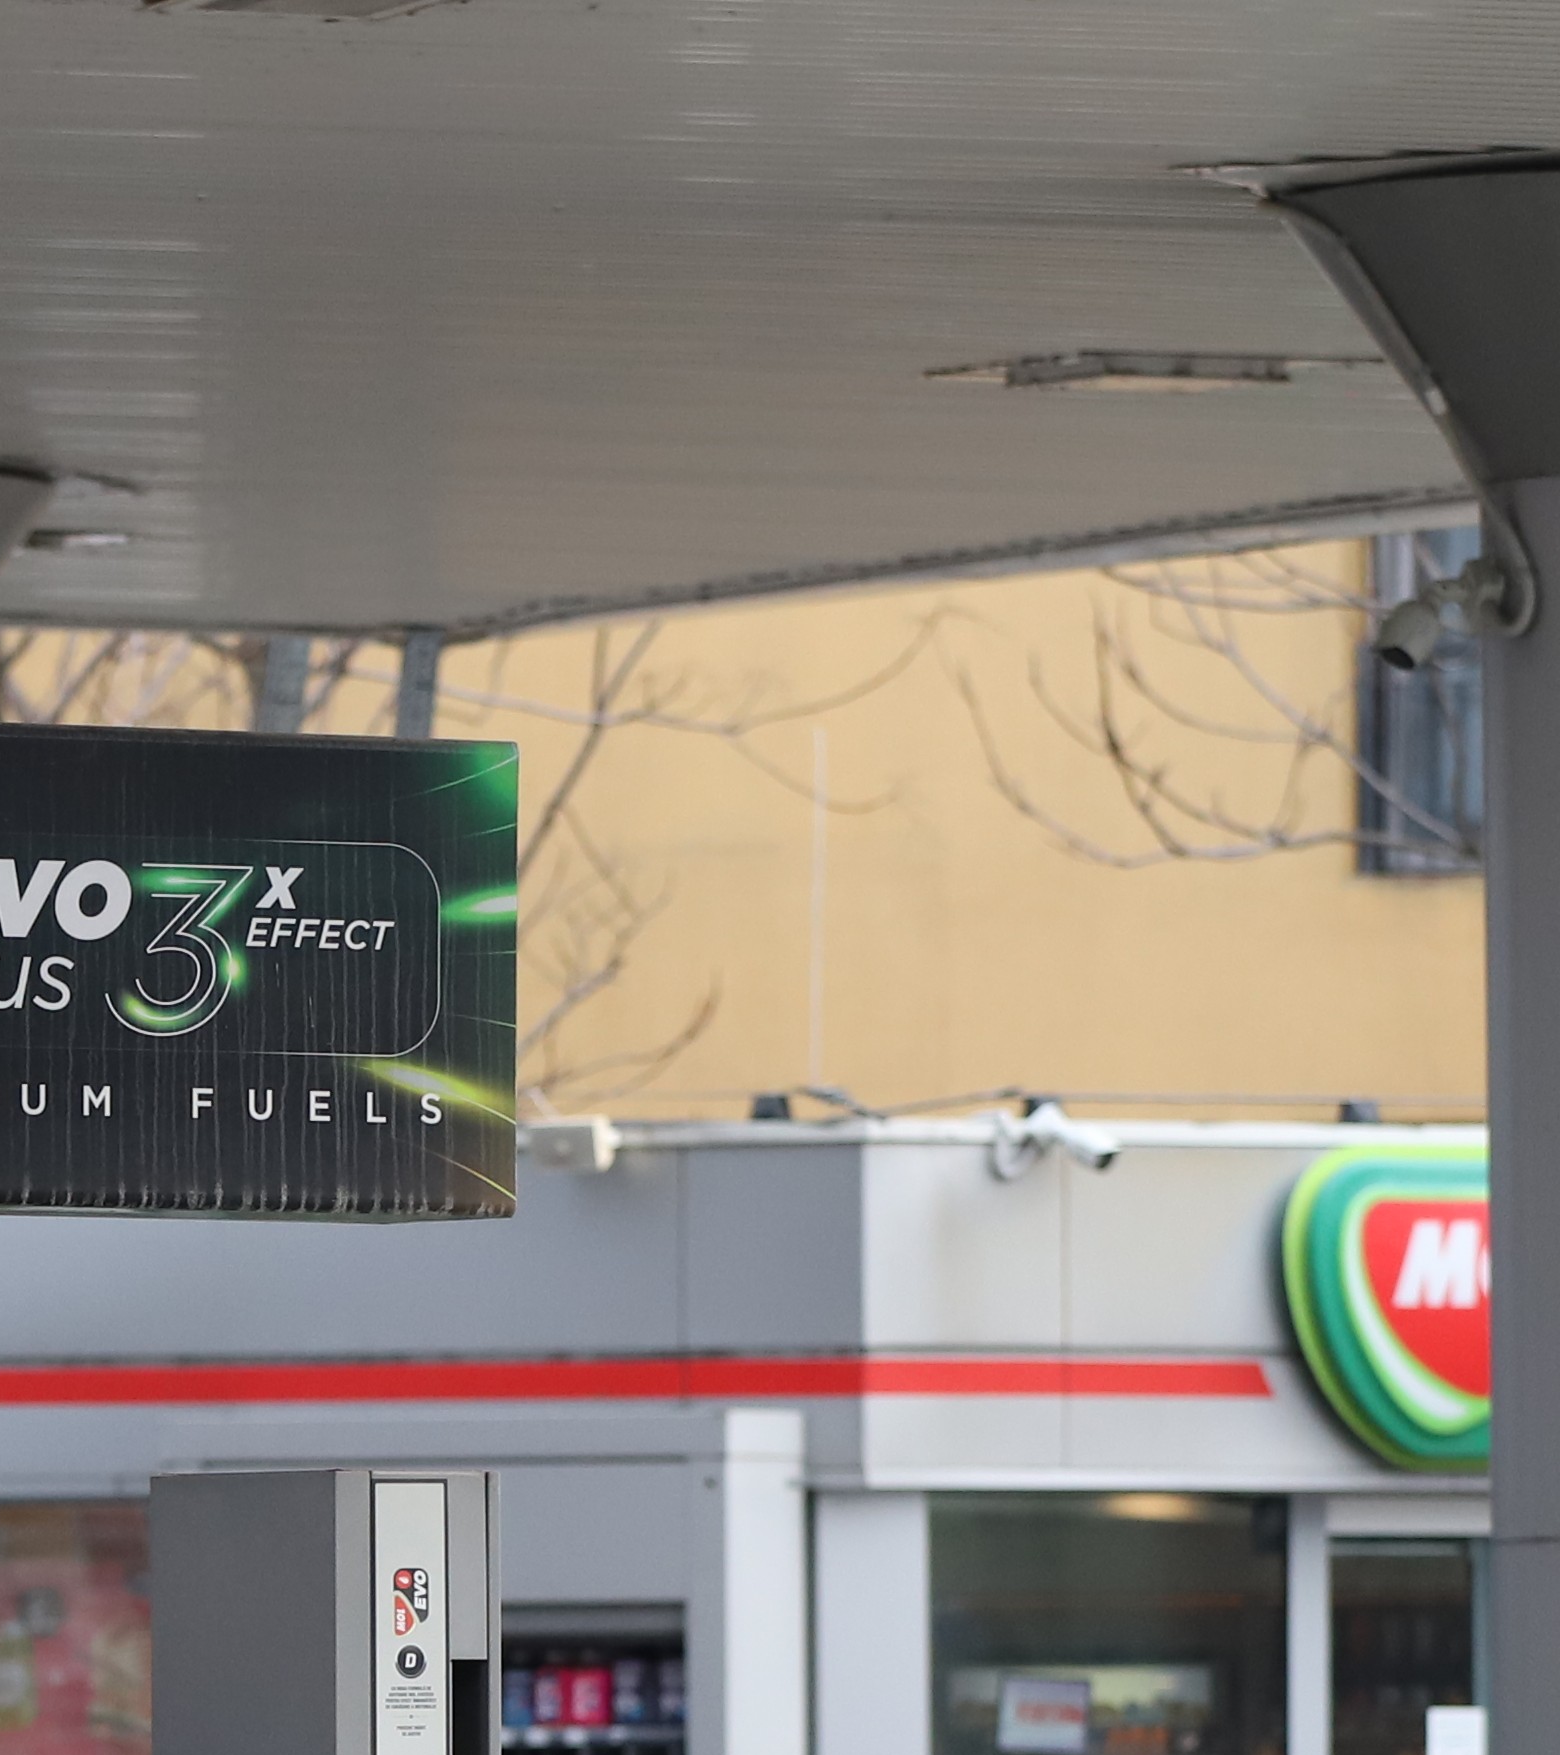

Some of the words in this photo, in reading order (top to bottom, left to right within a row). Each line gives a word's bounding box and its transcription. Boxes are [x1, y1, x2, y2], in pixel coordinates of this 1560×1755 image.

[105, 863, 252, 1037] 3
[245, 918, 394, 951] EFFECT
[192, 1088, 442, 1125] FUELS
[413, 1570, 427, 1610] EVO
[396, 1608, 406, 1632] MOL
[405, 1653, 417, 1668] D
